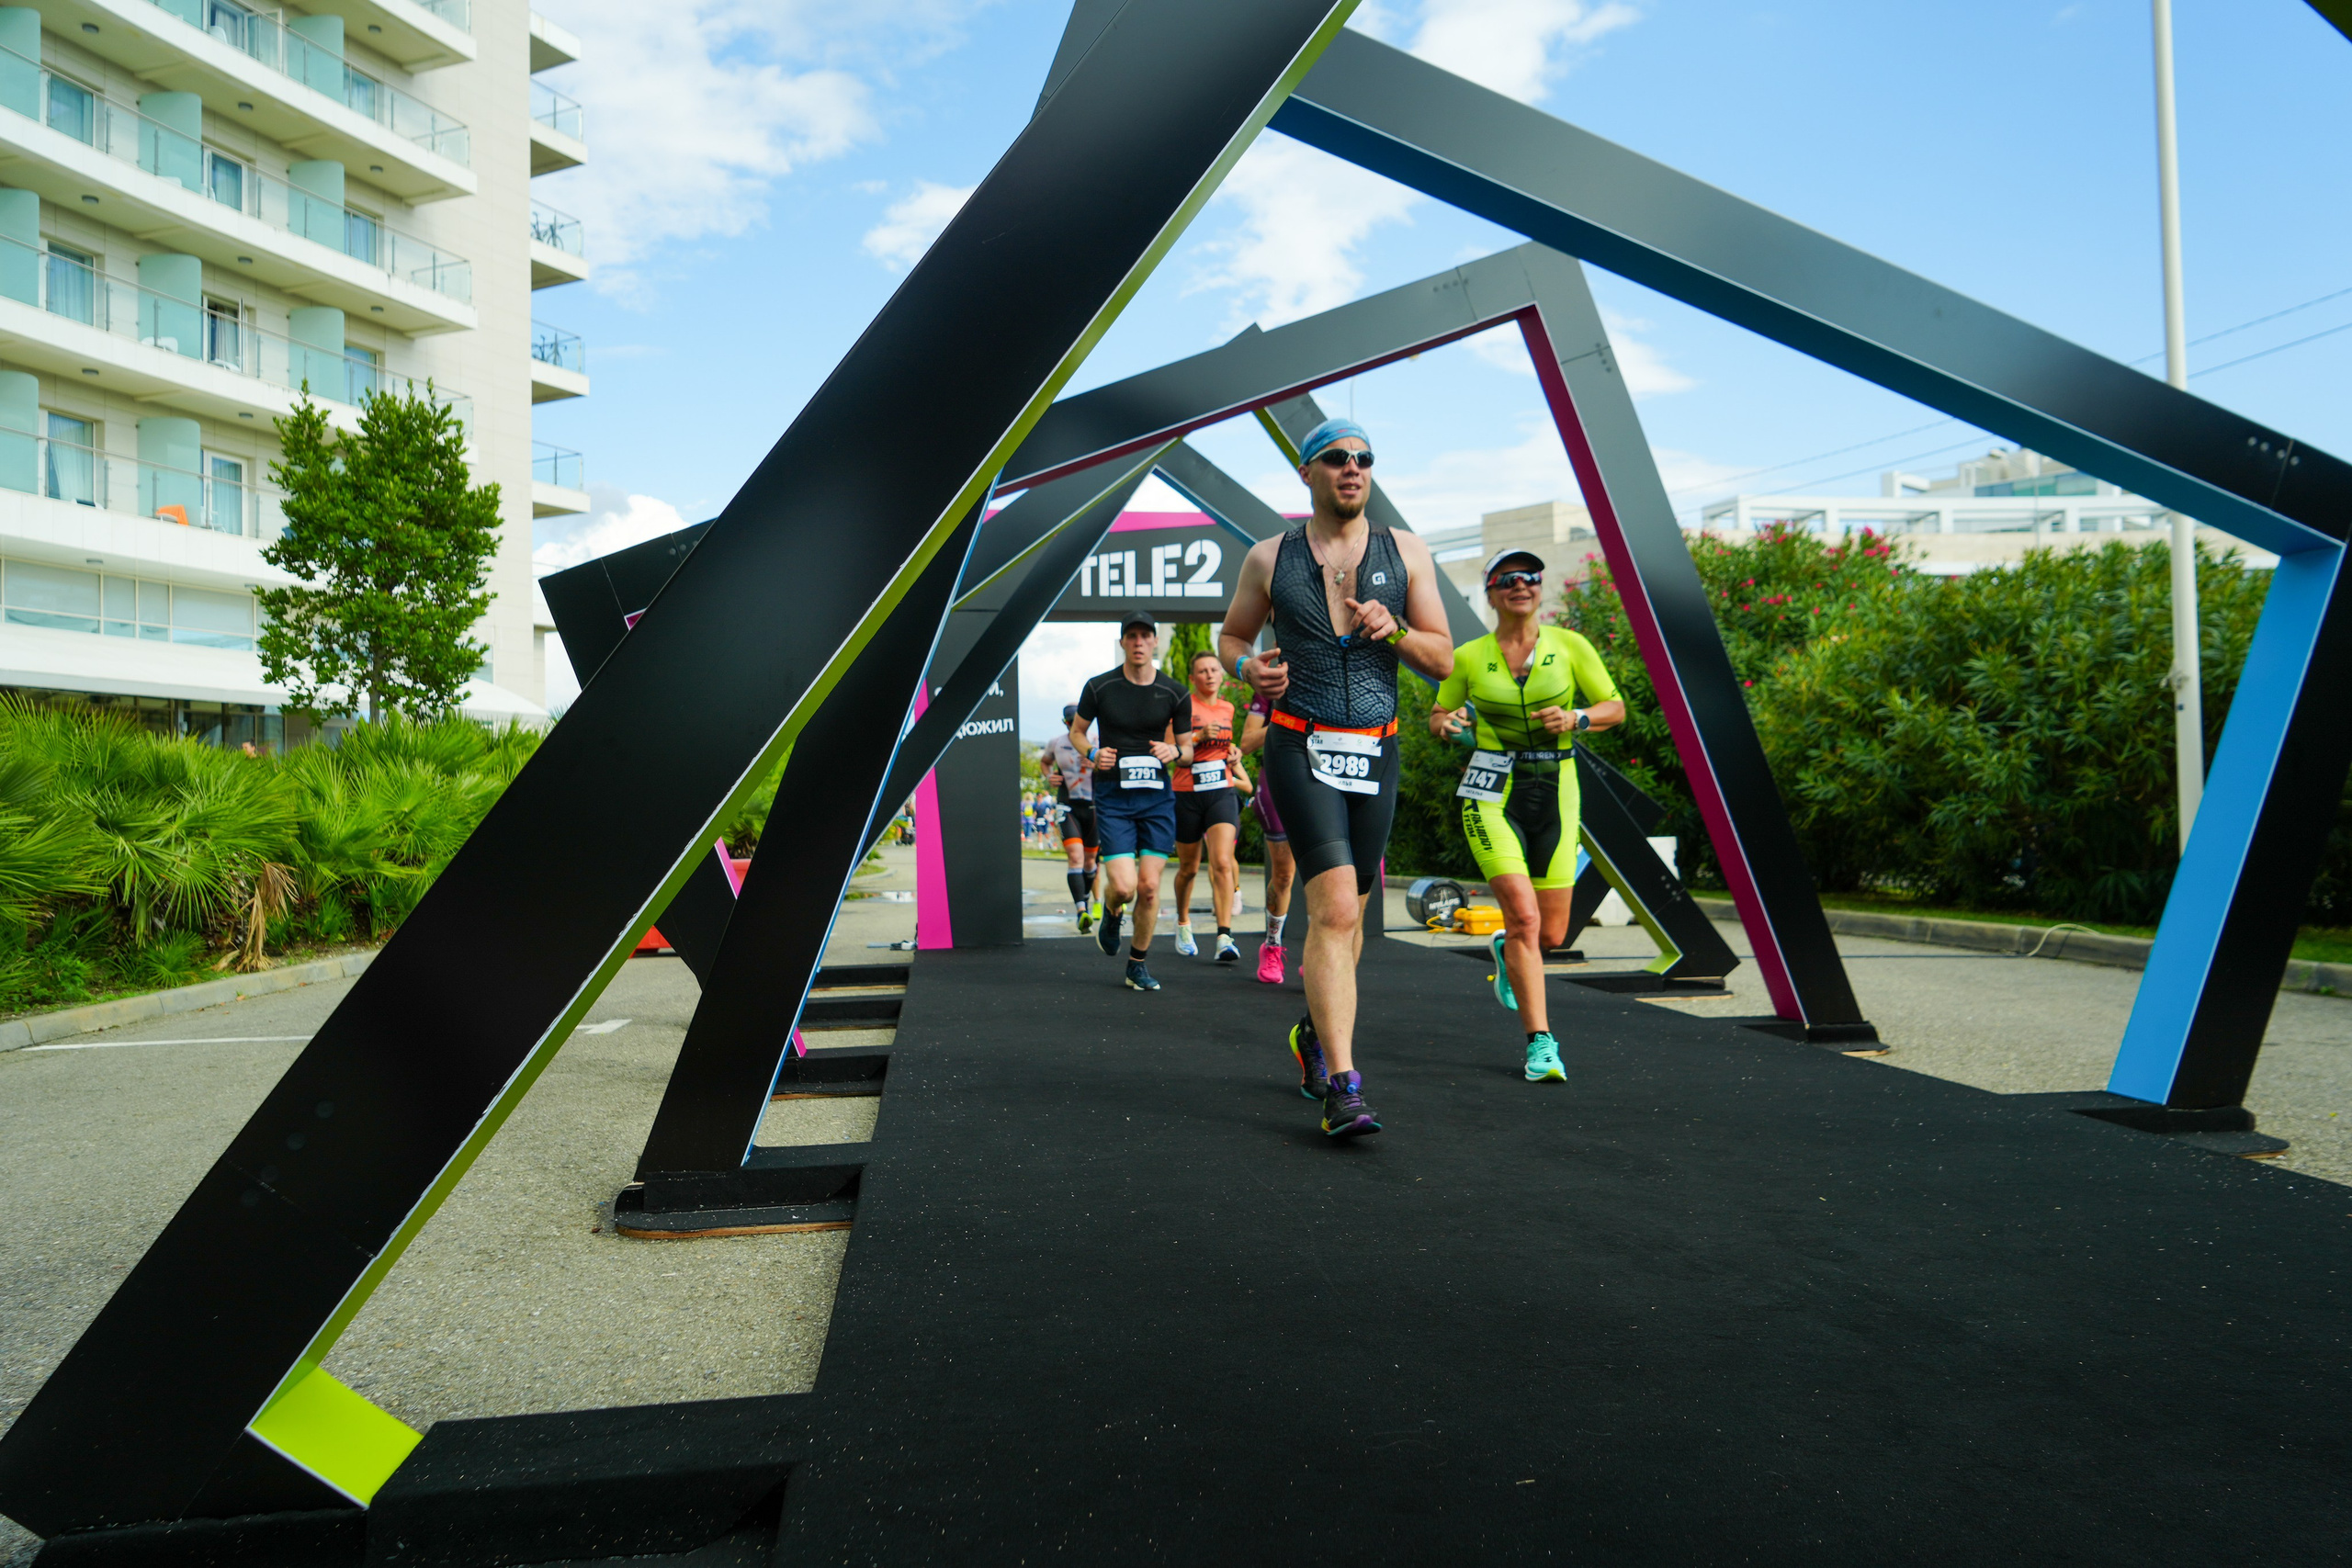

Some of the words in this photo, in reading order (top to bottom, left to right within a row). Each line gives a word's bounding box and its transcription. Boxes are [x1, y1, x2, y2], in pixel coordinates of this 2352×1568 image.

[1081, 539, 1223, 597] TELE2
[1128, 767, 1157, 780] 2791
[1319, 753, 1370, 778] 2989
[1199, 771, 1221, 784] 3557
